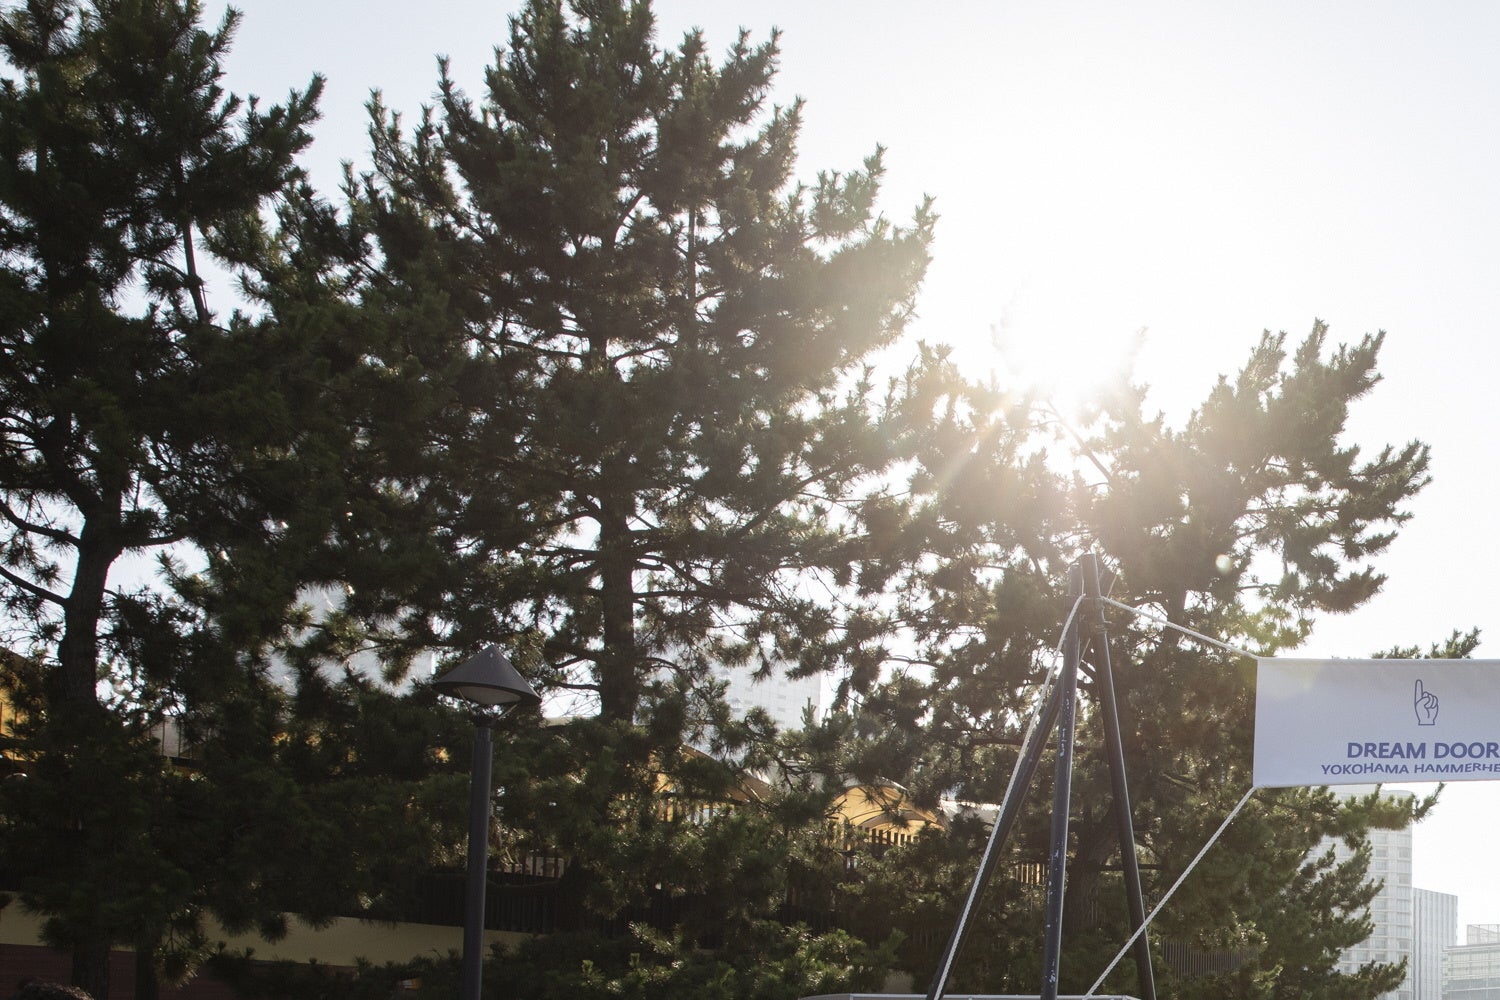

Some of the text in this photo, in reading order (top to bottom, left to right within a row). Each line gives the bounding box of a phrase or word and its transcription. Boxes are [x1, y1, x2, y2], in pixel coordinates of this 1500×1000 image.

[1347, 742, 1500, 759] DREAM DOOR
[1321, 762, 1409, 775] YOKOHAMA
